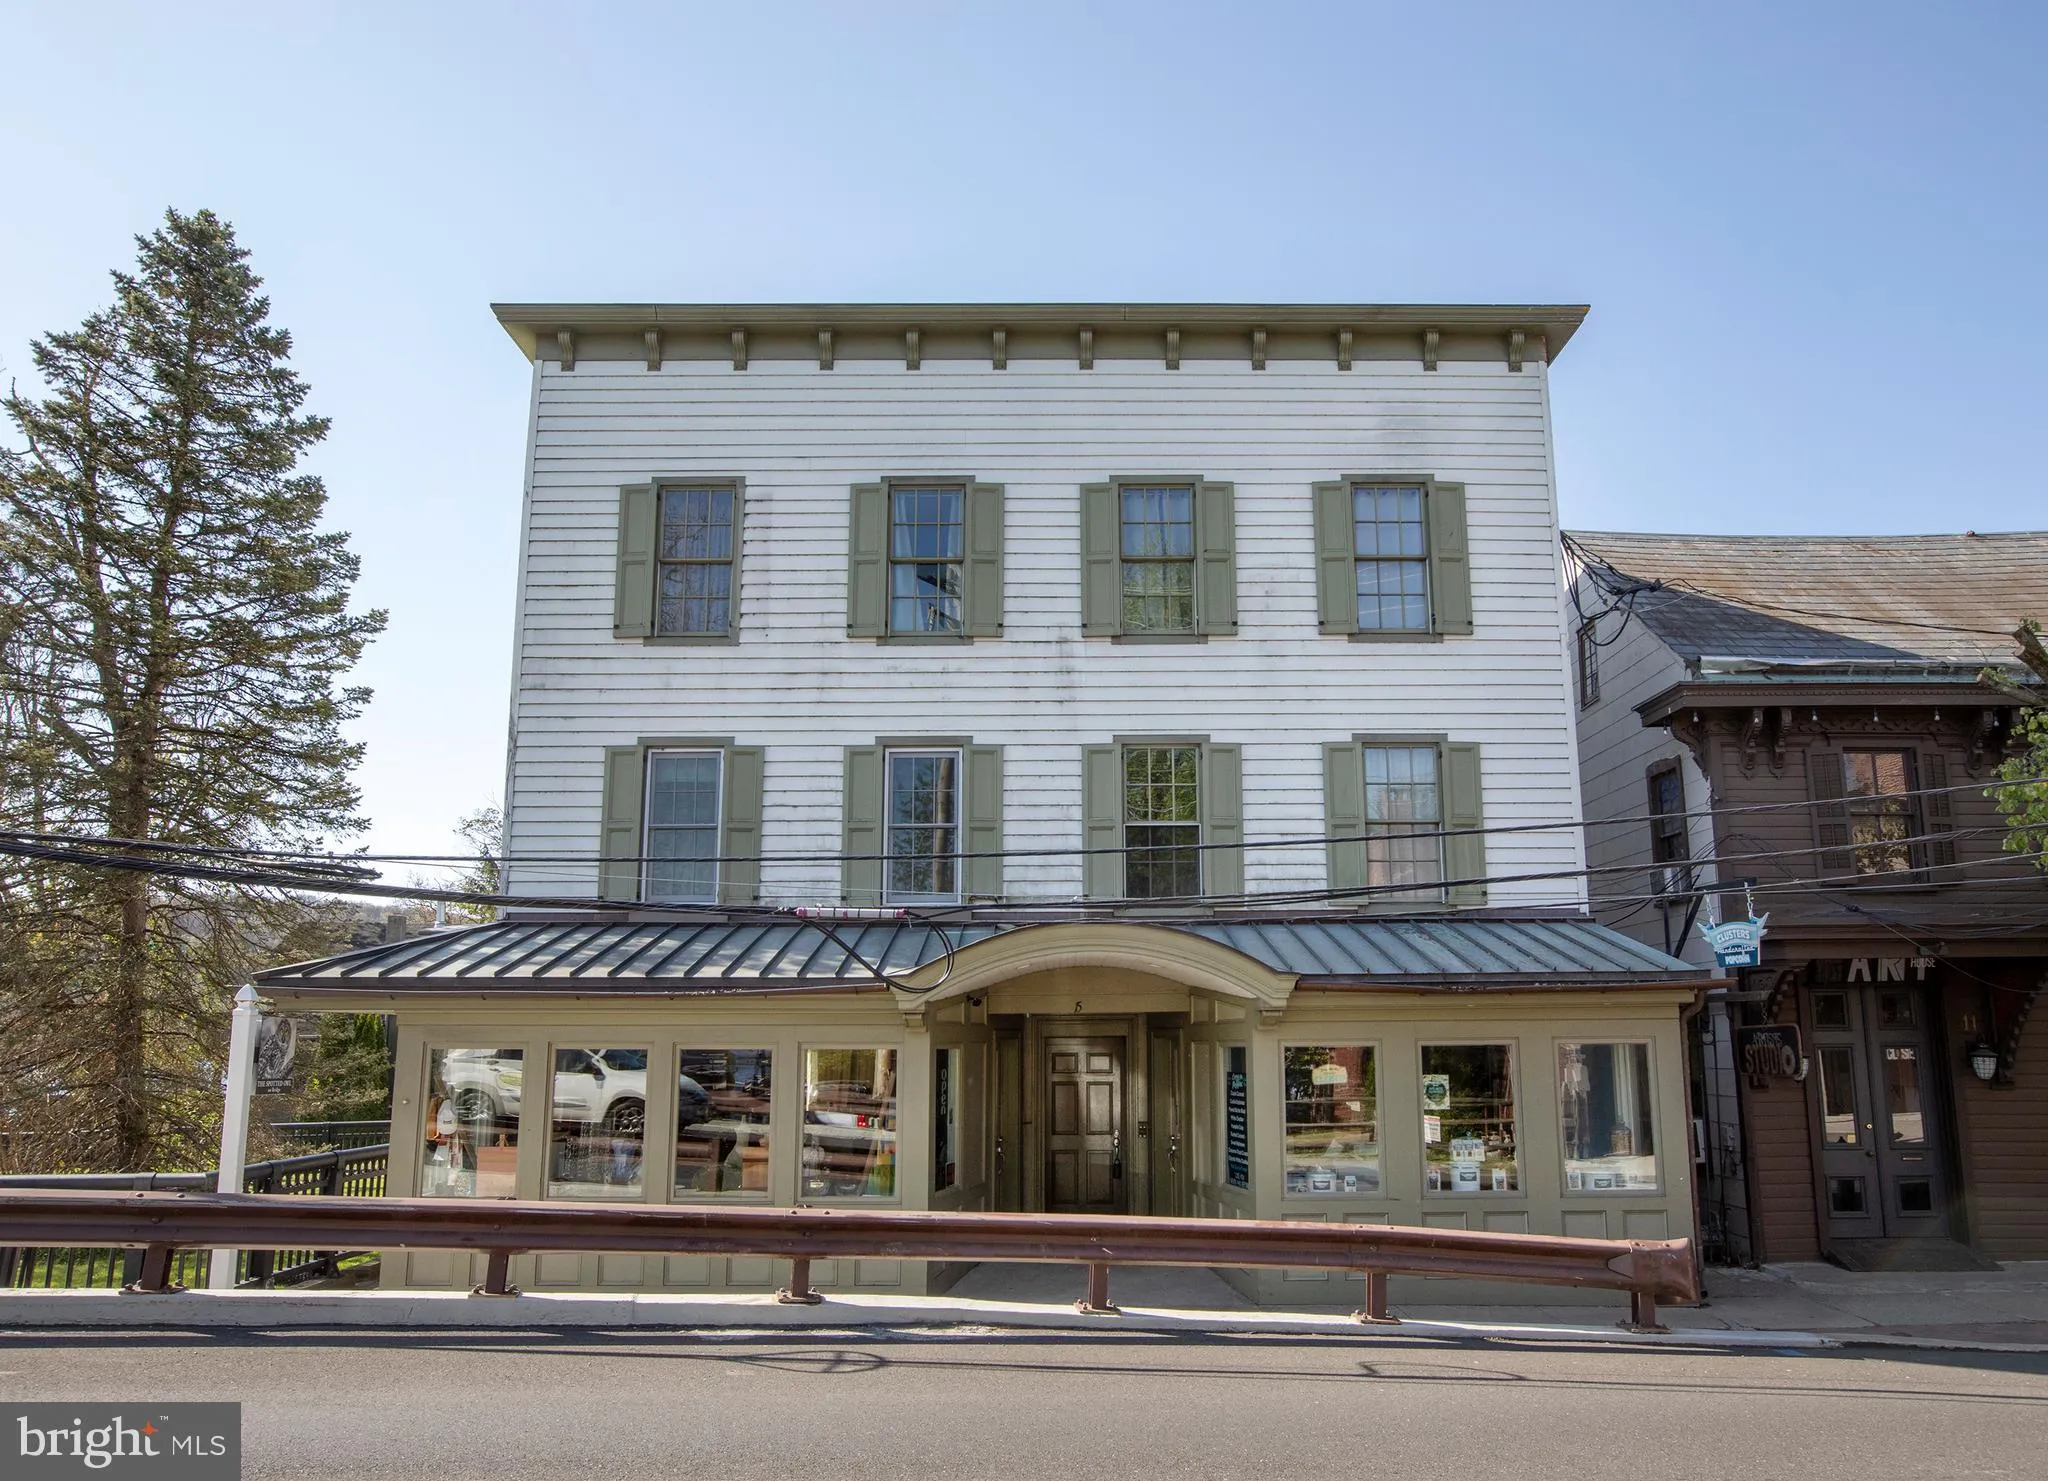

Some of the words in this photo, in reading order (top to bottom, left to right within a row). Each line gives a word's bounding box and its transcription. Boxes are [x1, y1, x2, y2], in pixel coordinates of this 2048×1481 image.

[1716, 929, 1751, 943] CLUSTERS
[1724, 954, 1751, 965] POPCORN
[1963, 1014, 1977, 1031] 11
[1744, 1044, 1796, 1076] STUDIO
